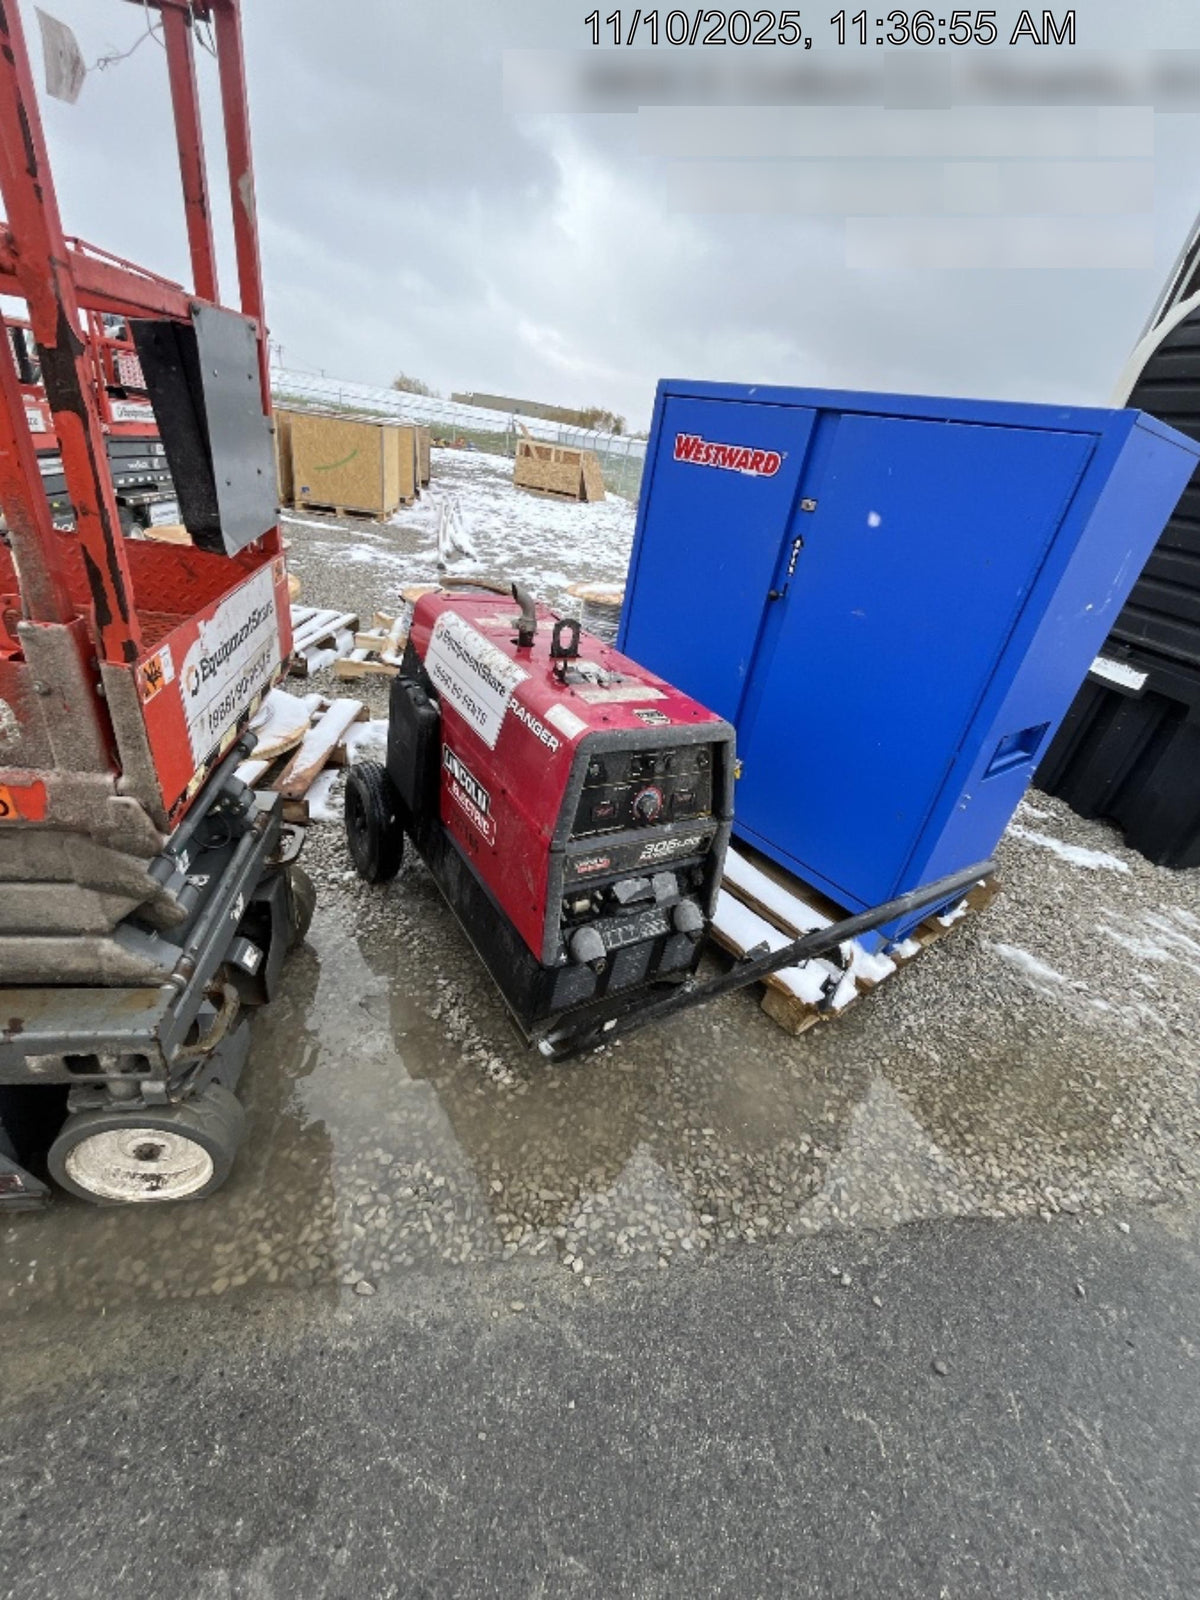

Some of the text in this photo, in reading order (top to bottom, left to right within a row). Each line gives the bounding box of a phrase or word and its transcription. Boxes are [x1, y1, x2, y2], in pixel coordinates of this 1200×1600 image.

[674, 433, 781, 476] WESTWARD
[509, 698, 559, 752] RANGER
[443, 749, 487, 814] LINCOLN
